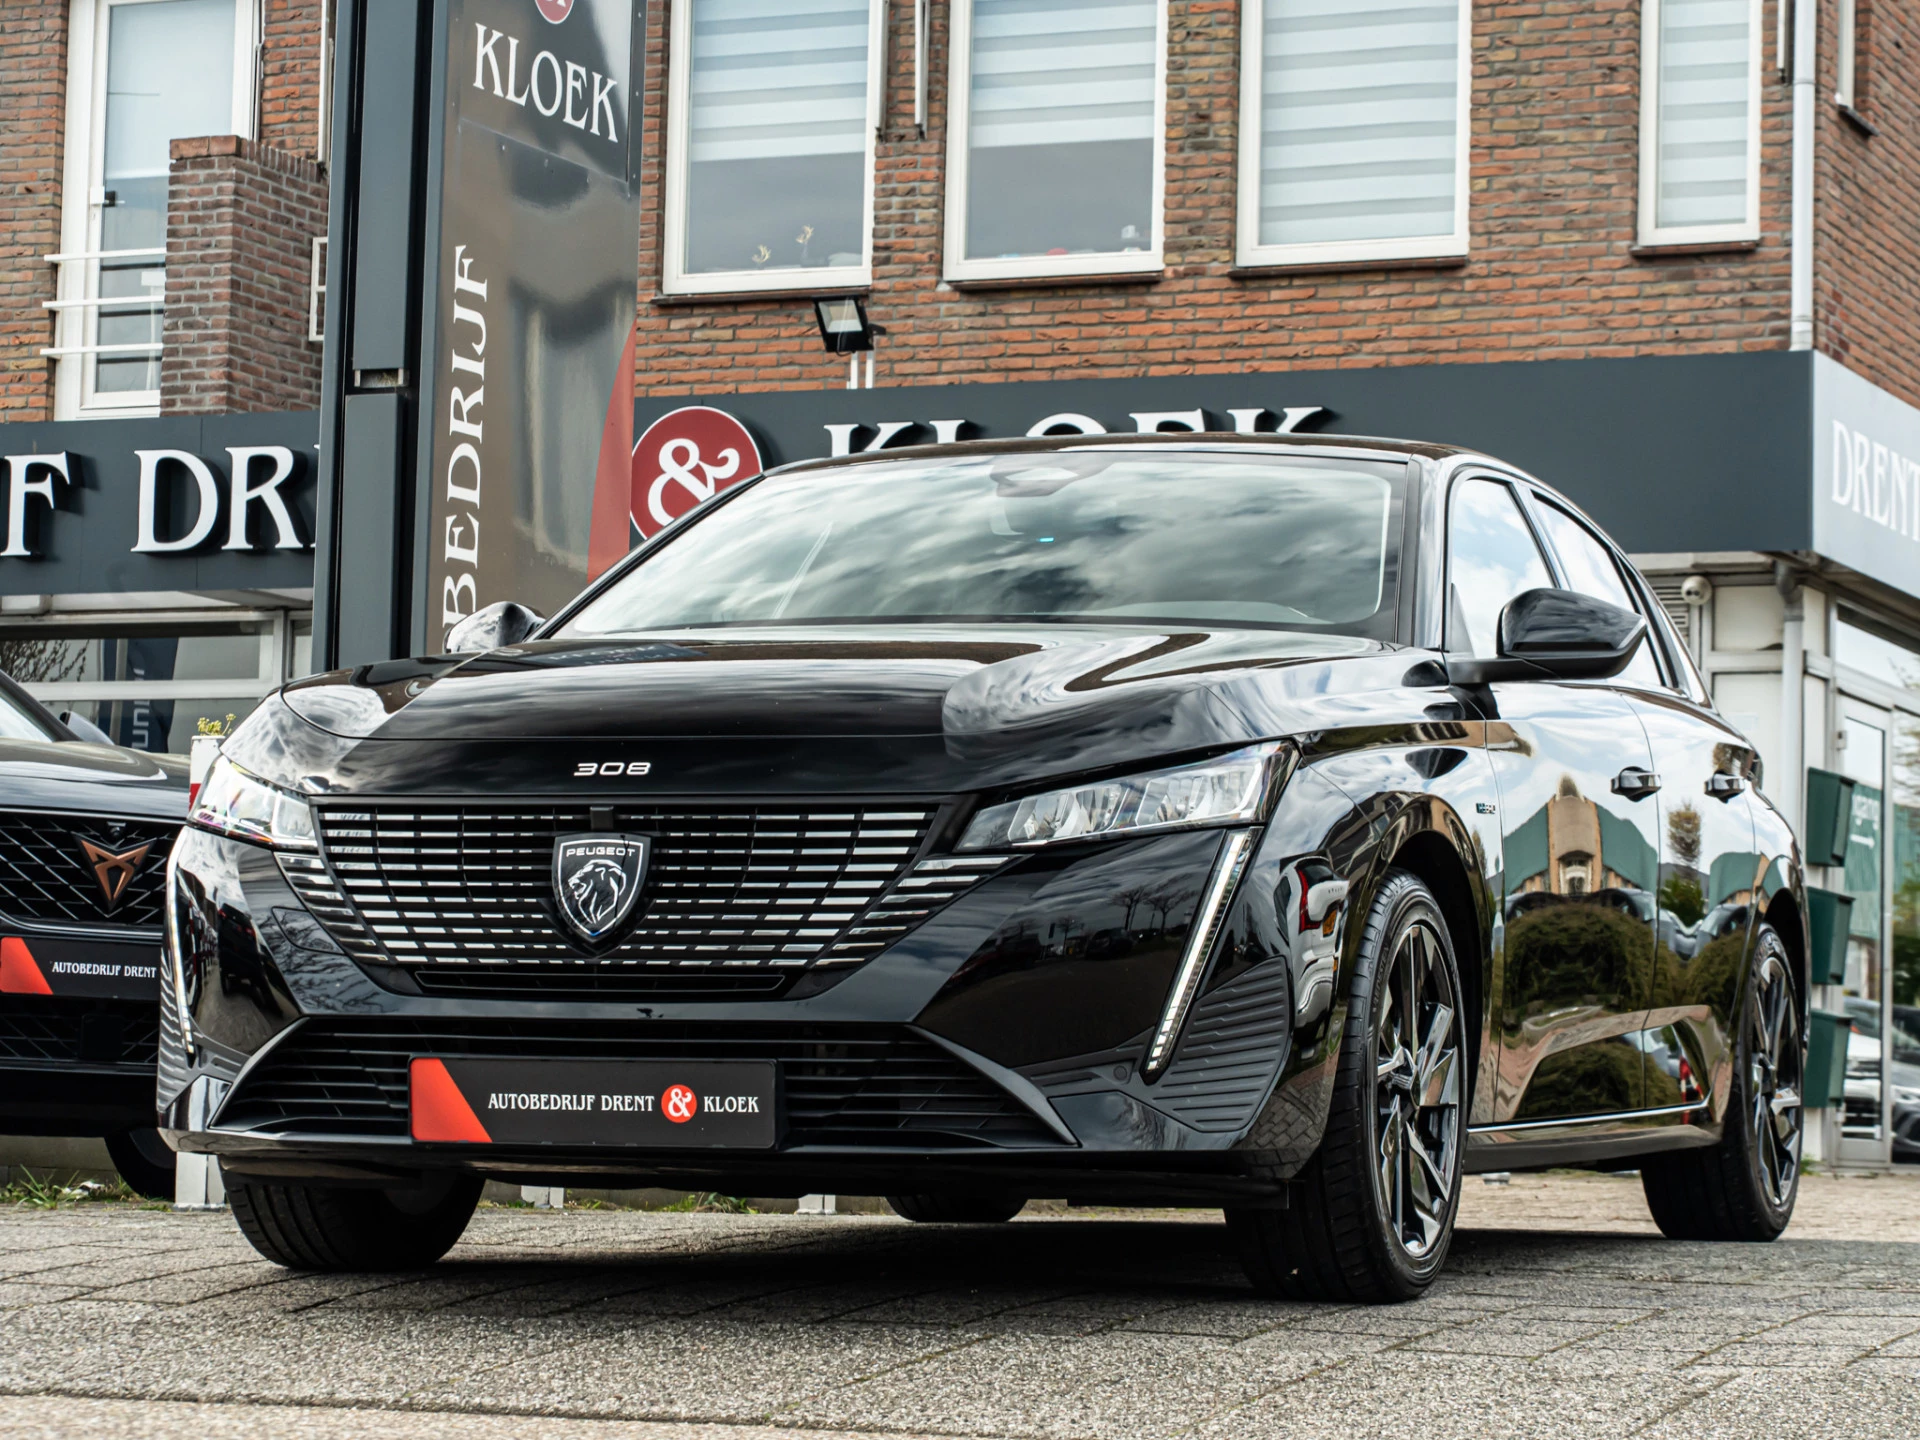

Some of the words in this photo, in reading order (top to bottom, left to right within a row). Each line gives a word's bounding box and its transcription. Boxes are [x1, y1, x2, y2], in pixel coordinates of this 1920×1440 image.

[473, 22, 618, 143] KLOEK
[573, 762, 651, 776] 308
[566, 847, 635, 857] PEUGEOT
[51, 961, 121, 976] AUTOBEDRIJF
[123, 964, 156, 978] DRENT
[488, 1093, 595, 1110] AUTOBEDRIJF
[600, 1095, 654, 1112] DRENT
[703, 1096, 759, 1113] KLOEK
